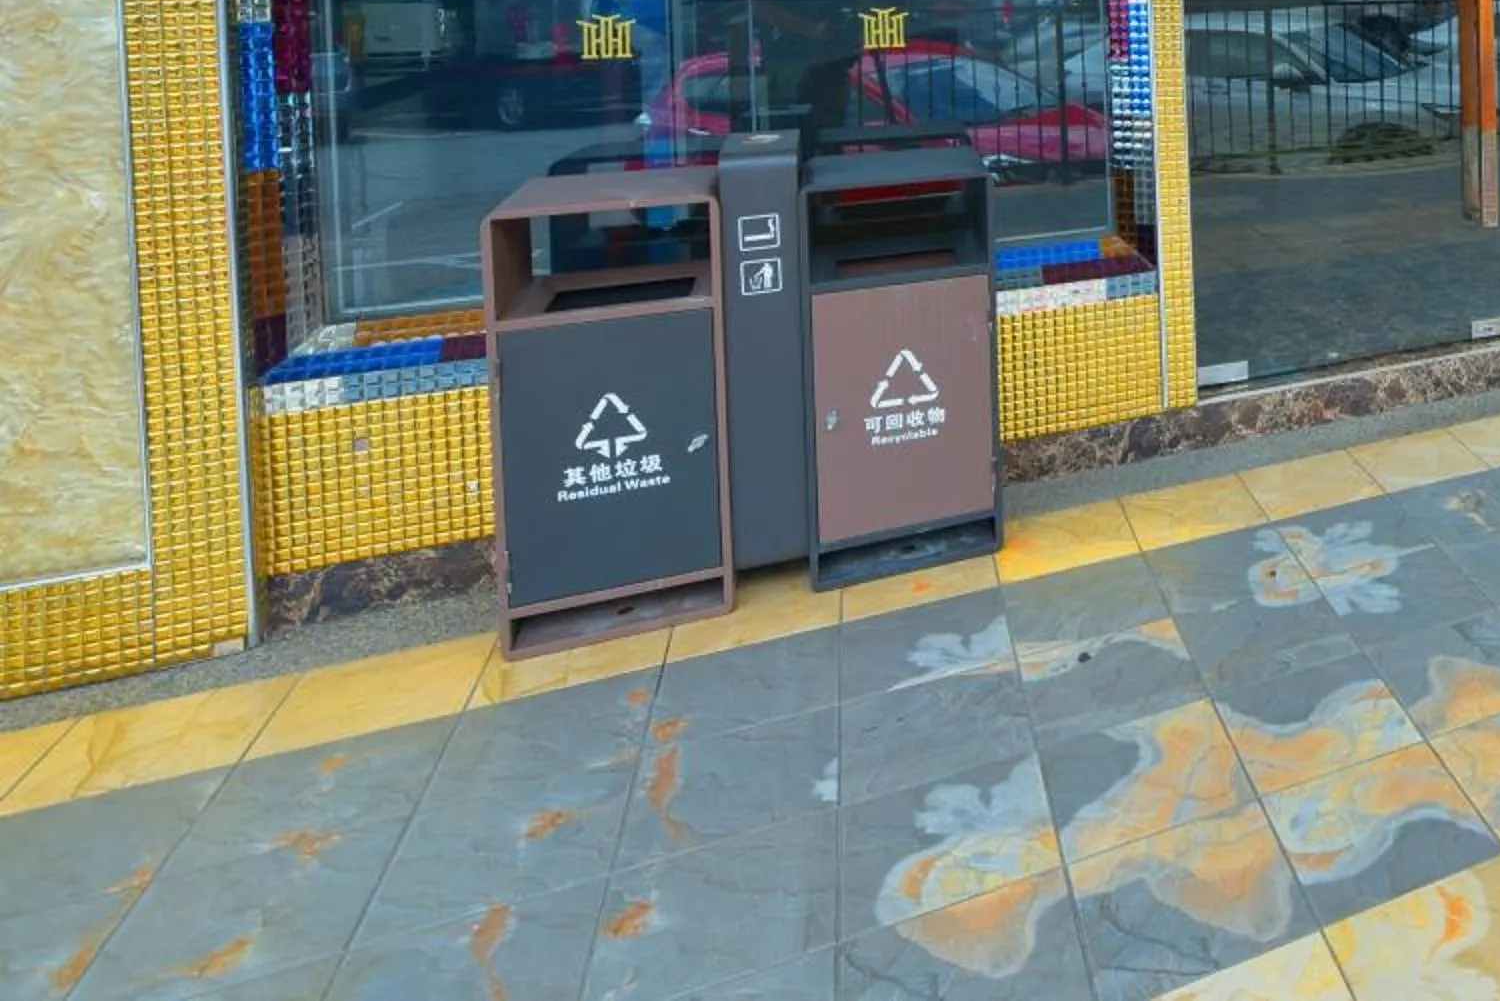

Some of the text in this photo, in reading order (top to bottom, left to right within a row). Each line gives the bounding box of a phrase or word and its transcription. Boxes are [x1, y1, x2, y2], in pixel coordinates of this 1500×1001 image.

[864, 407, 945, 433] 可回收物
[563, 454, 663, 488] 其他垃圾
[557, 475, 671, 502] Residual Waste
